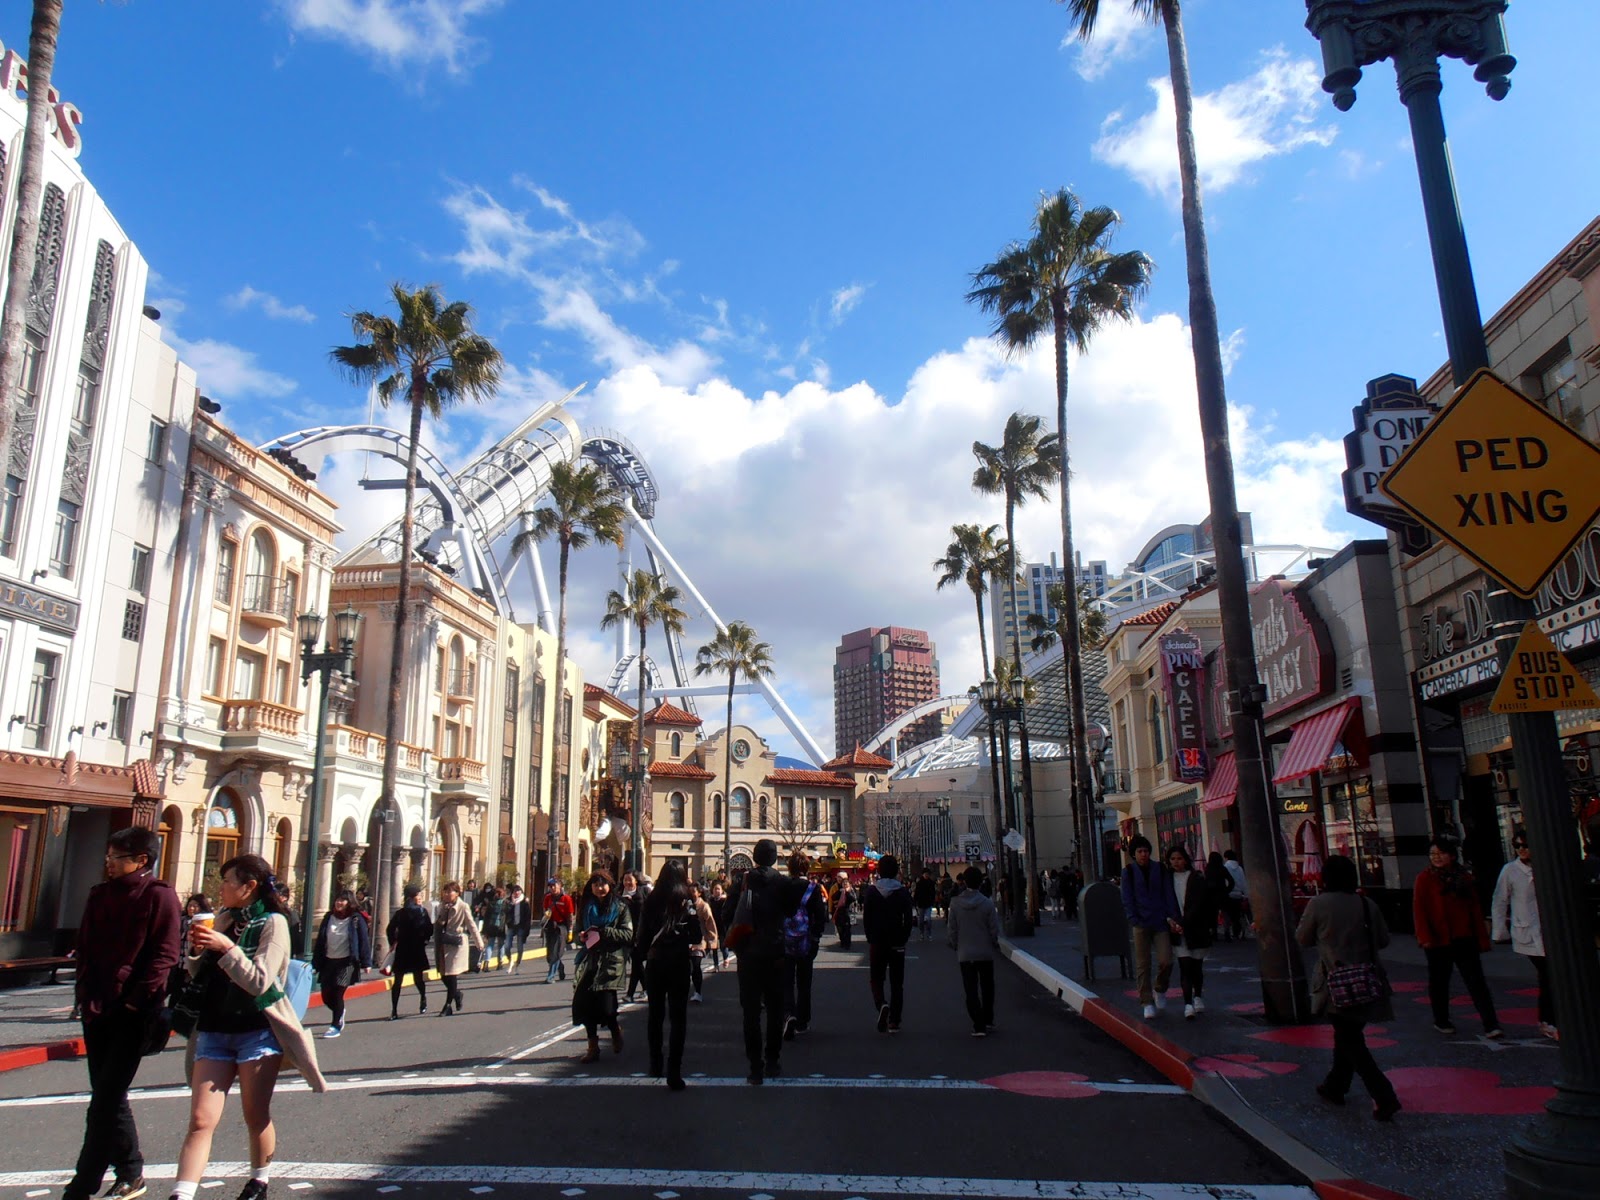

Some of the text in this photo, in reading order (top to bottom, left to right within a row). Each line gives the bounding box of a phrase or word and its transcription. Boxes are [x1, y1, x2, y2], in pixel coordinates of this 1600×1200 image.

[1455, 436, 1549, 472] PED
[1453, 489, 1568, 527] XING
[0, 586, 68, 620] IME
[1421, 606, 1454, 662] The
[1166, 652, 1203, 674] PINK
[1519, 651, 1561, 674] BUS
[1514, 674, 1575, 700] STOP
[1176, 672, 1196, 739] CAFE
[1498, 699, 1595, 710] PACIFIC ELECTRIC
[1284, 799, 1309, 812] Candy
[966, 846, 980, 856] 30
